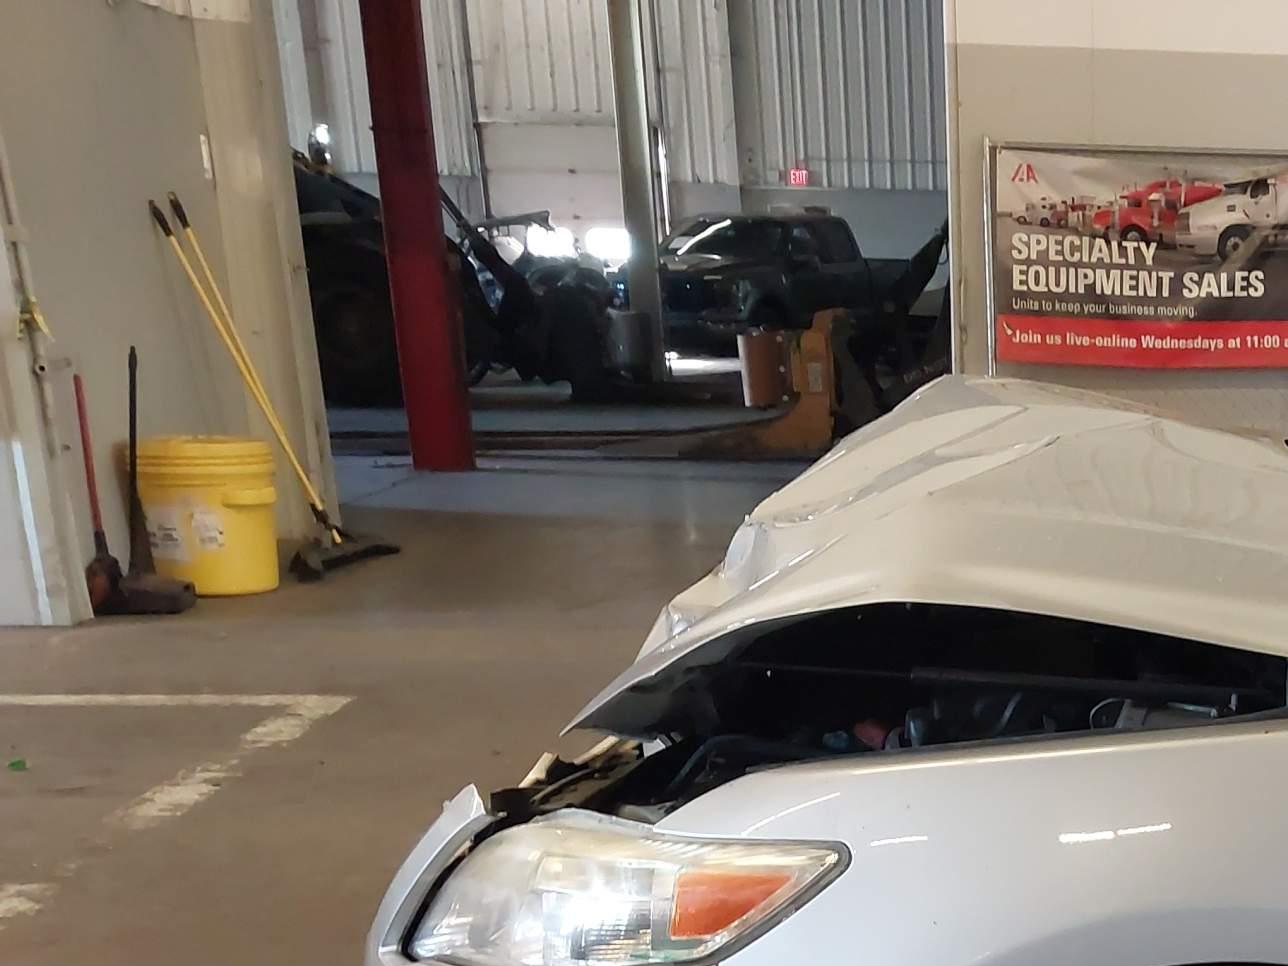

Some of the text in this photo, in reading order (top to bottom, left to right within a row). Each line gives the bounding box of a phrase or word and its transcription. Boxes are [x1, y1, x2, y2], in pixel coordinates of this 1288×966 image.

[790, 169, 808, 185] EXIT
[1011, 232, 1158, 266] SPECIALTY
[1012, 264, 1265, 299] EQUIPMENT SALES
[1012, 297, 1198, 318] Units to keep your business moving.
[1012, 329, 1042, 343] Join
[1046, 334, 1062, 345] us
[1066, 331, 1137, 348] live-online
[1141, 335, 1224, 351] Wednesdays
[1228, 337, 1241, 348] at
[1246, 335, 1280, 348] 11:00
